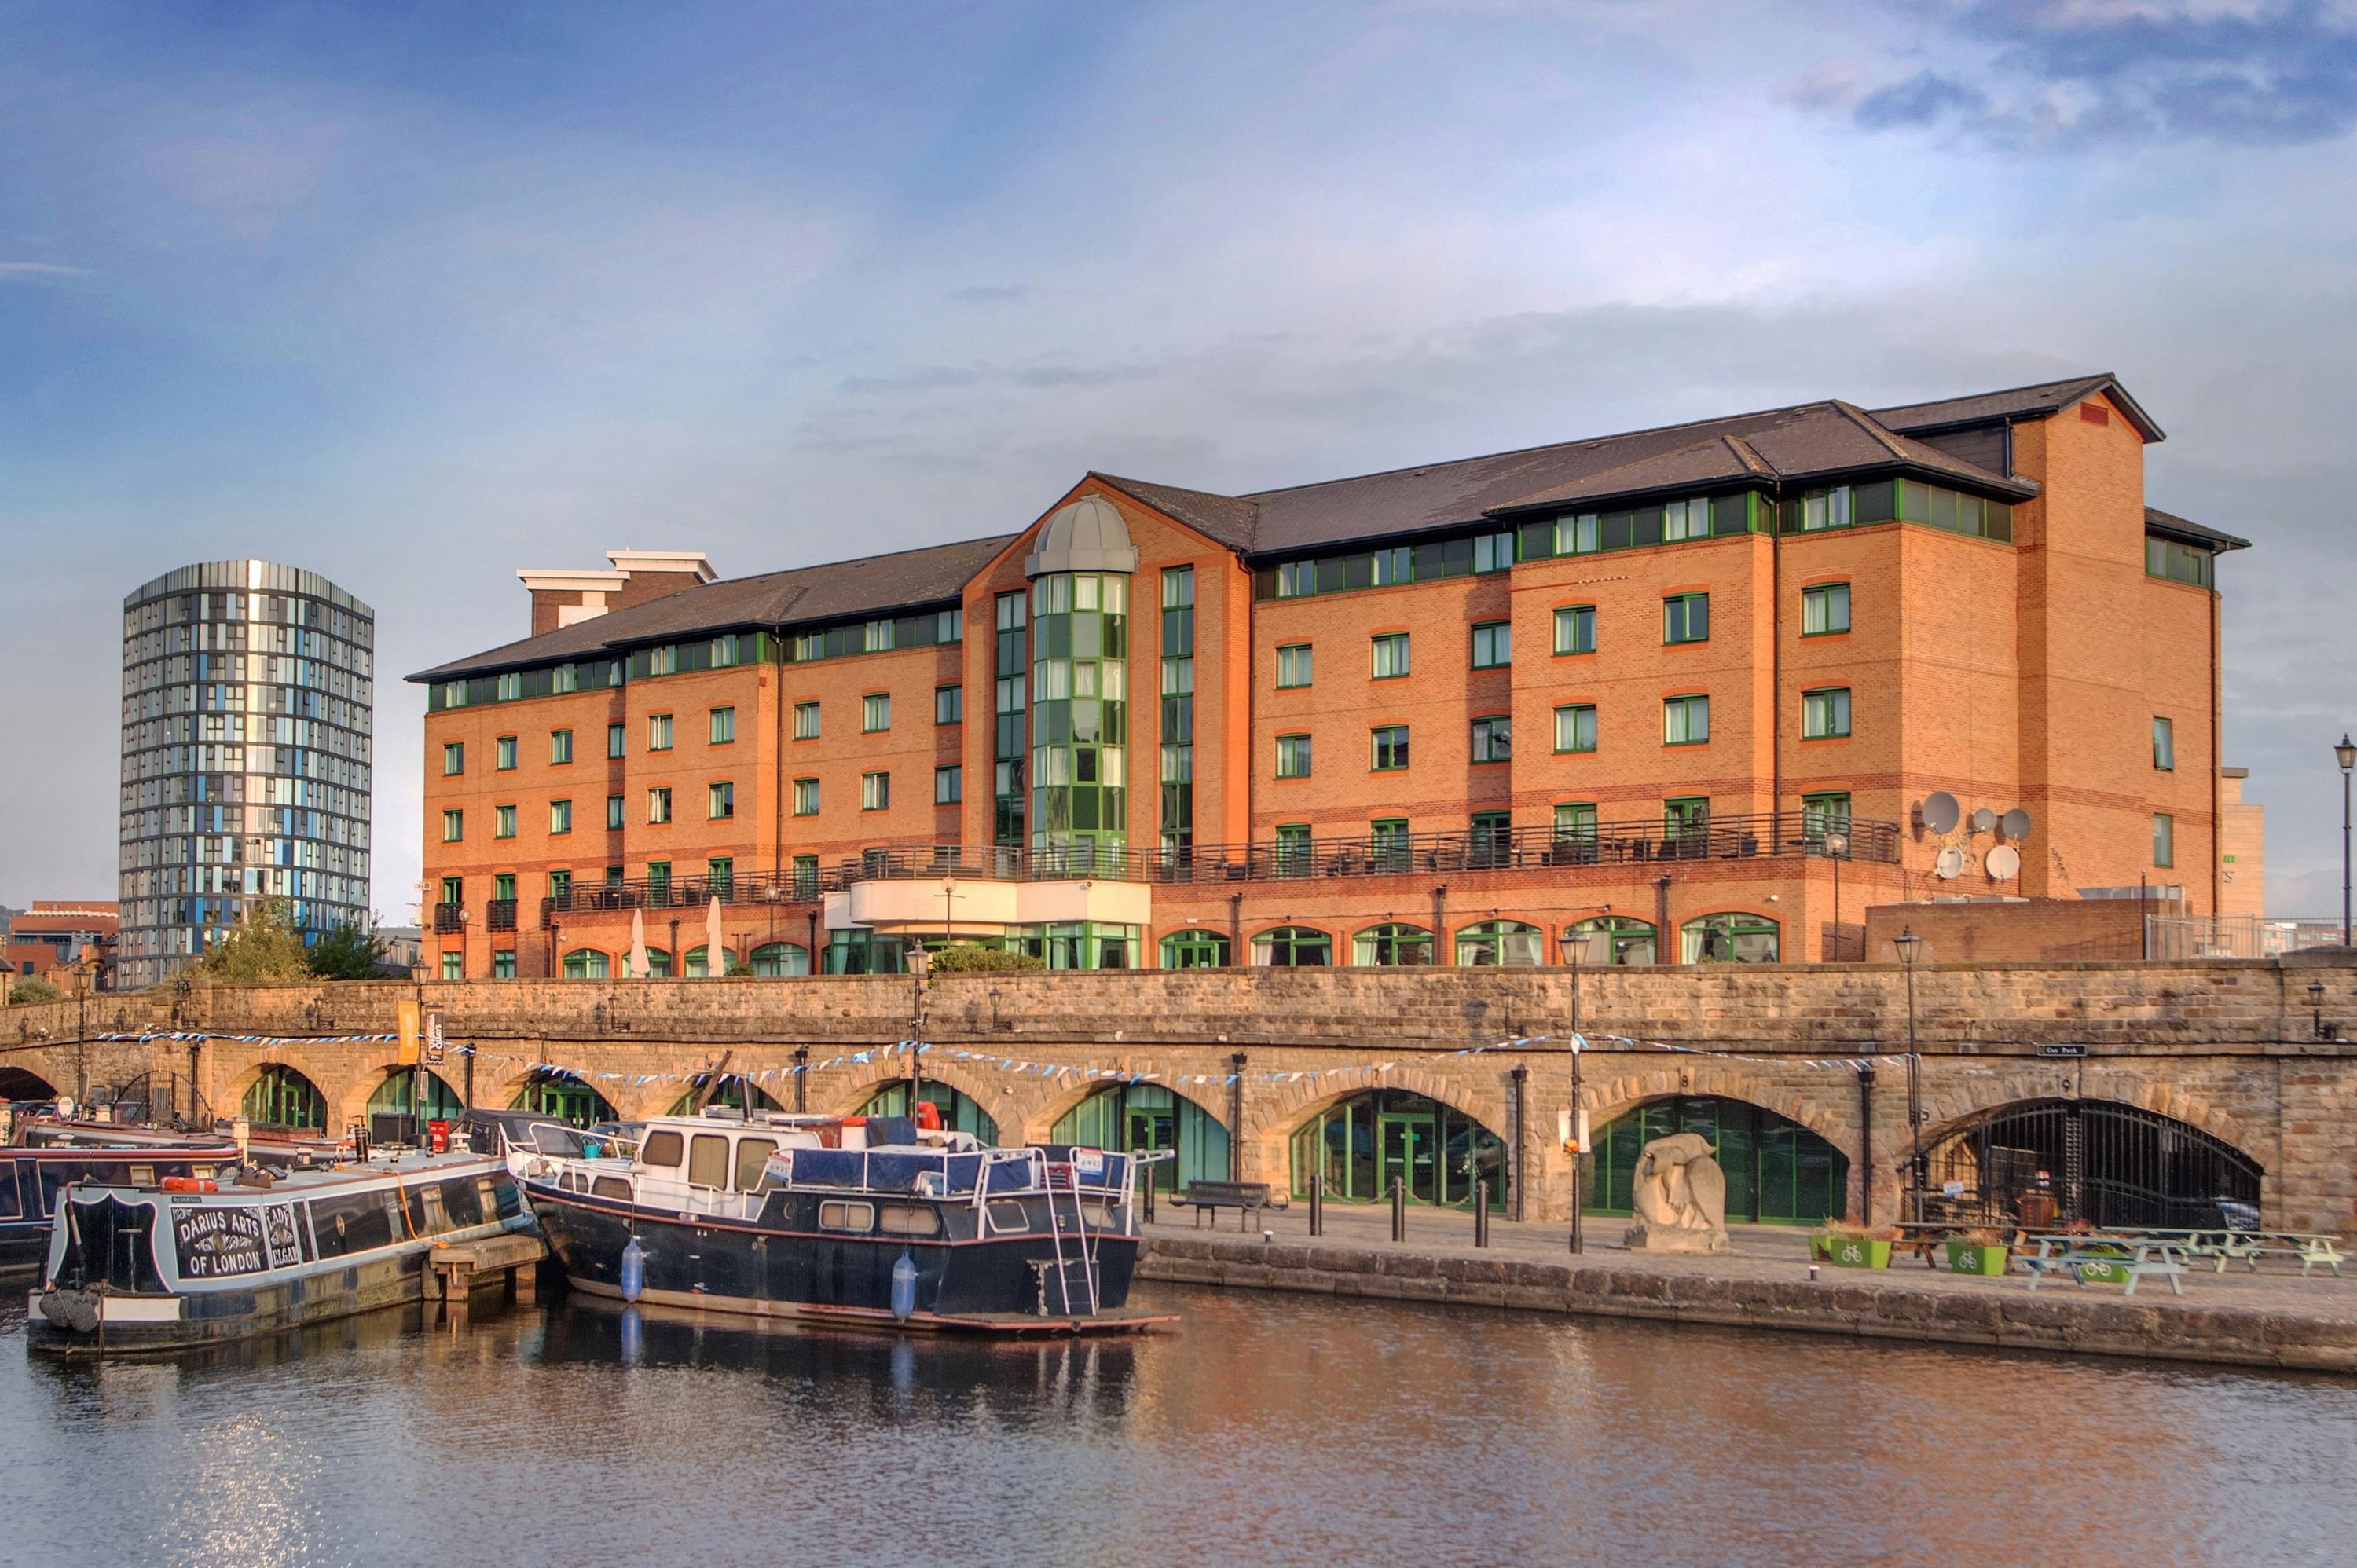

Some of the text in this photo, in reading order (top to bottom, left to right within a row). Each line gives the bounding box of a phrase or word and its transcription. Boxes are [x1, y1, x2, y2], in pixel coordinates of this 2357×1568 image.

[1681, 1075, 1688, 1087] 8
[2062, 1079, 2070, 1093] 9
[180, 1211, 259, 1242] DARIUS ARTS
[266, 1207, 289, 1230] LADY
[190, 1251, 262, 1275] OF LONDON
